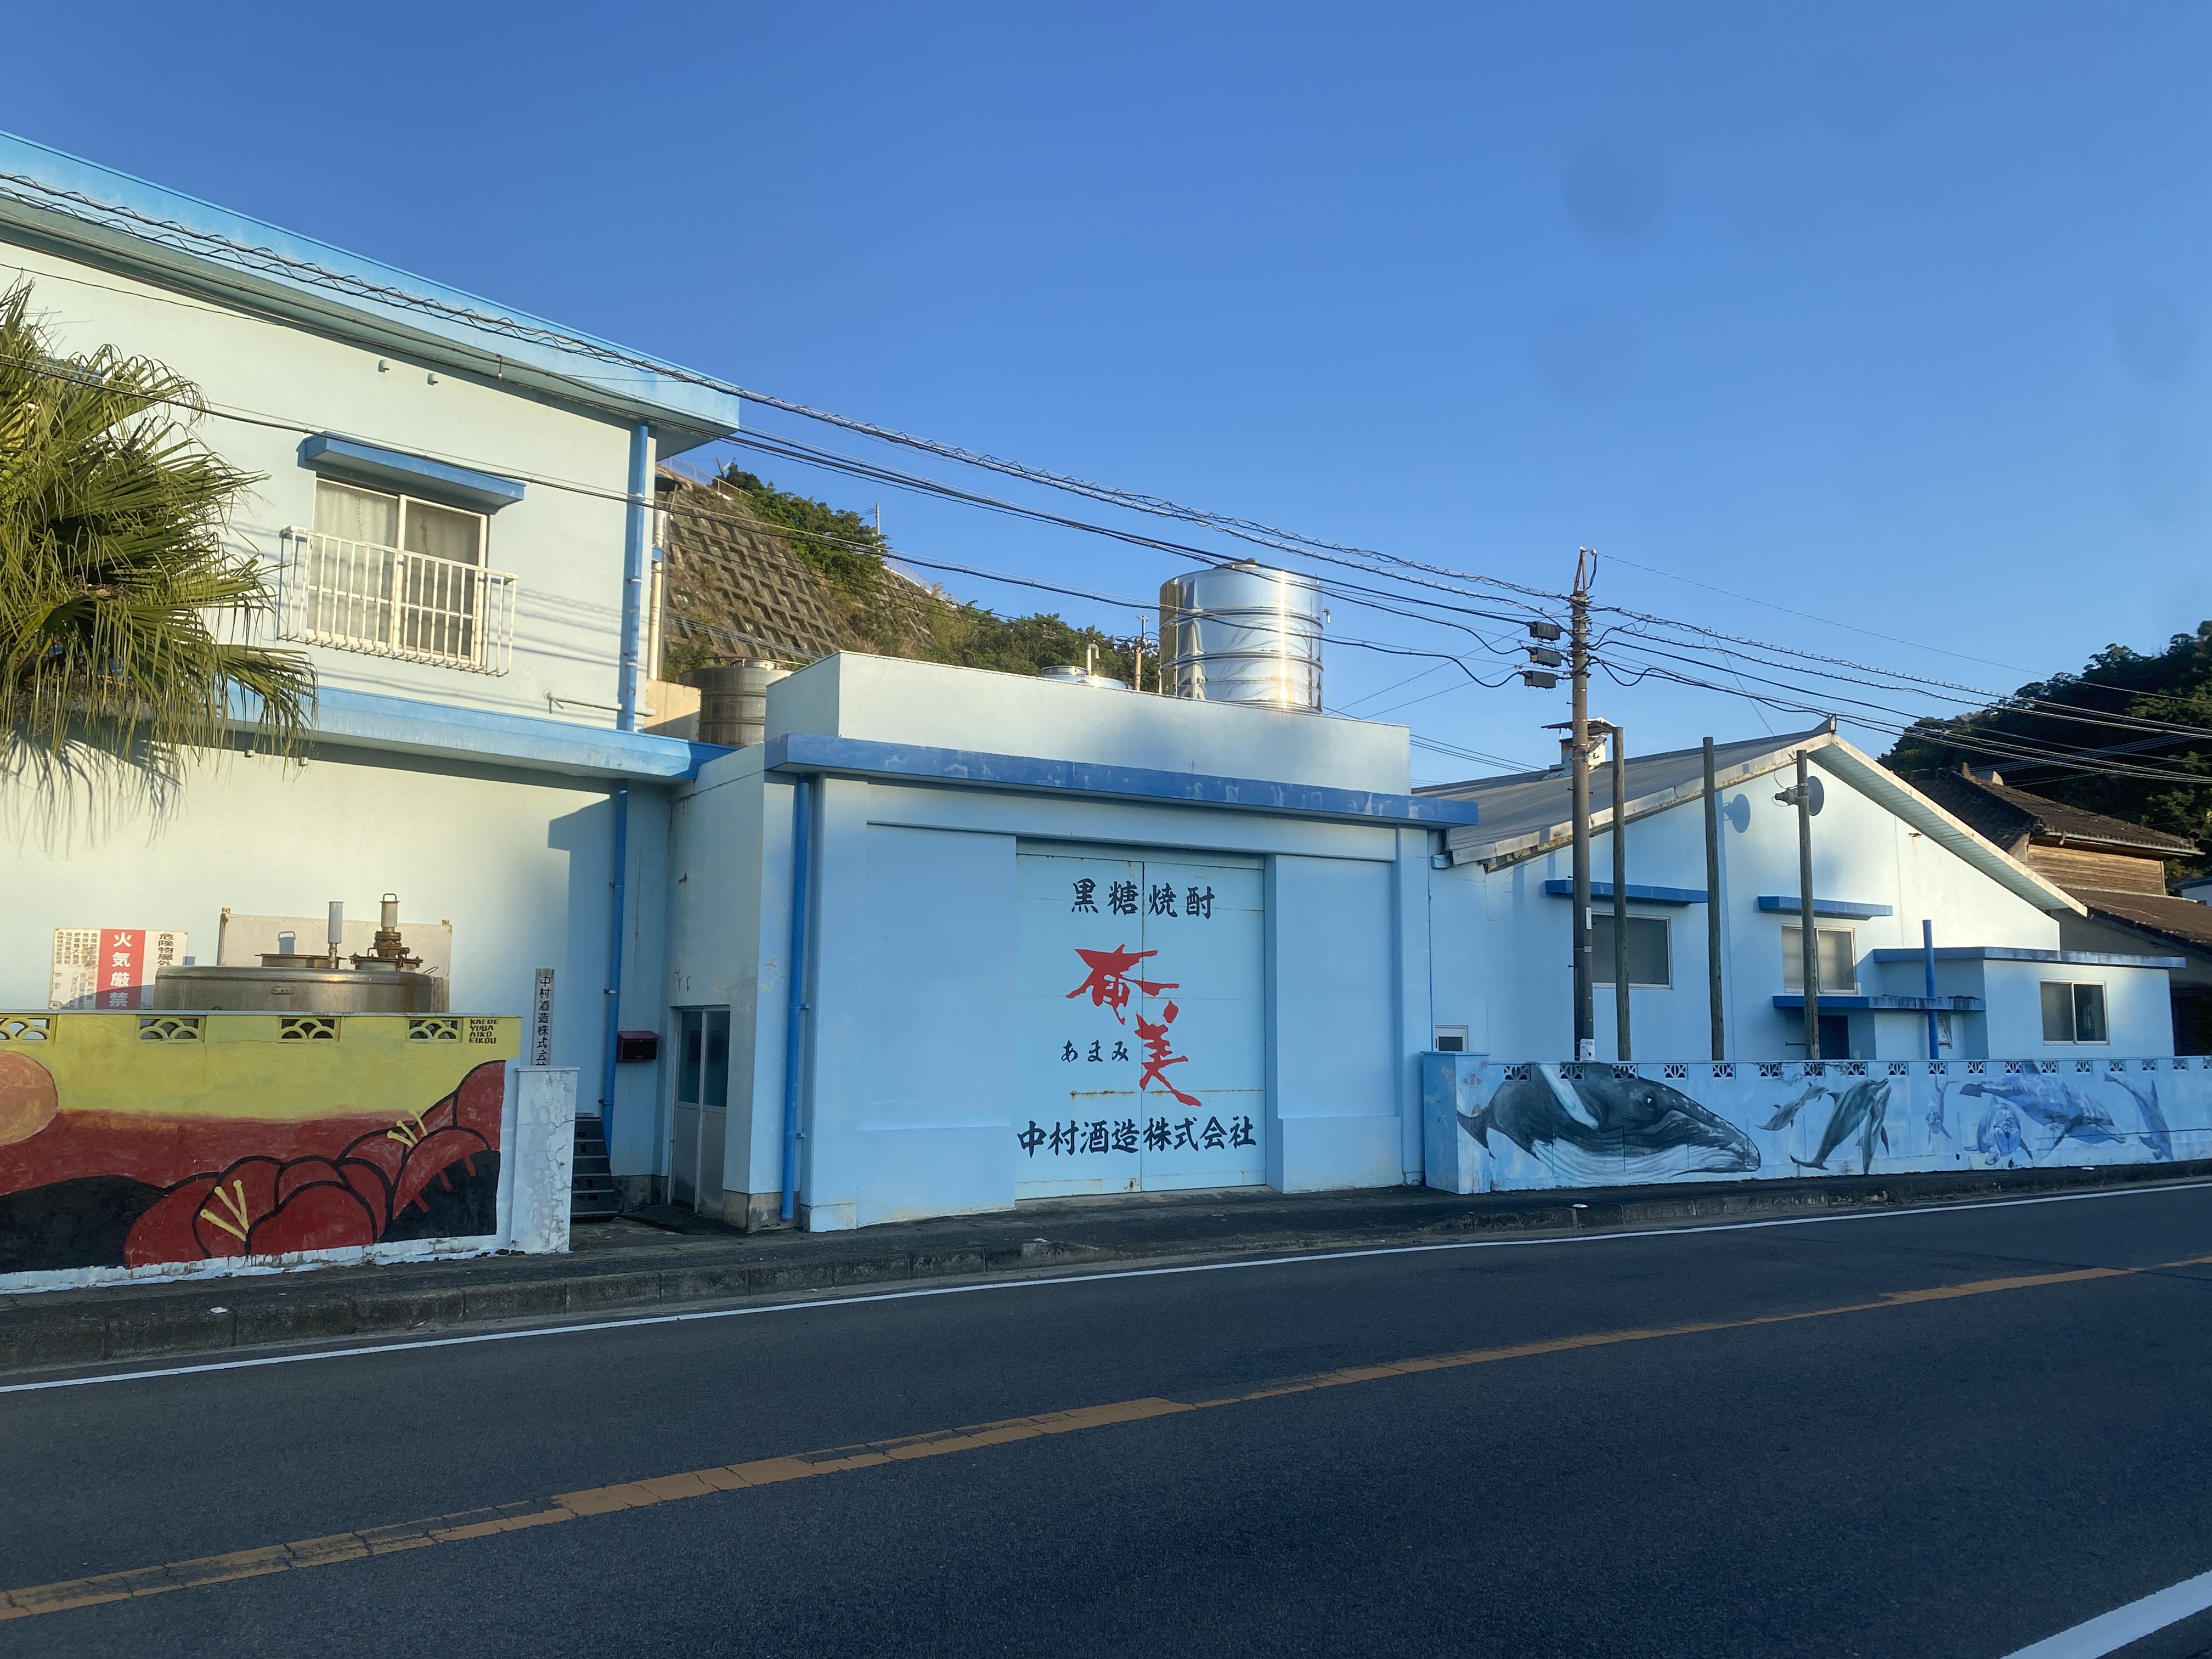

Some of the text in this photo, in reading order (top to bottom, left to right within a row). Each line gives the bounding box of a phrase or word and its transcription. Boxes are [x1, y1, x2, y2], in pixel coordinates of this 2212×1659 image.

[1071, 878, 1215, 919] 黒糖焼酎
[110, 932, 132, 1007] 火気厳禁
[1065, 944, 1202, 1107] 奄美
[1061, 1040, 1129, 1063] あまみ
[1017, 1115, 1256, 1158] 中村酒造株式会社
